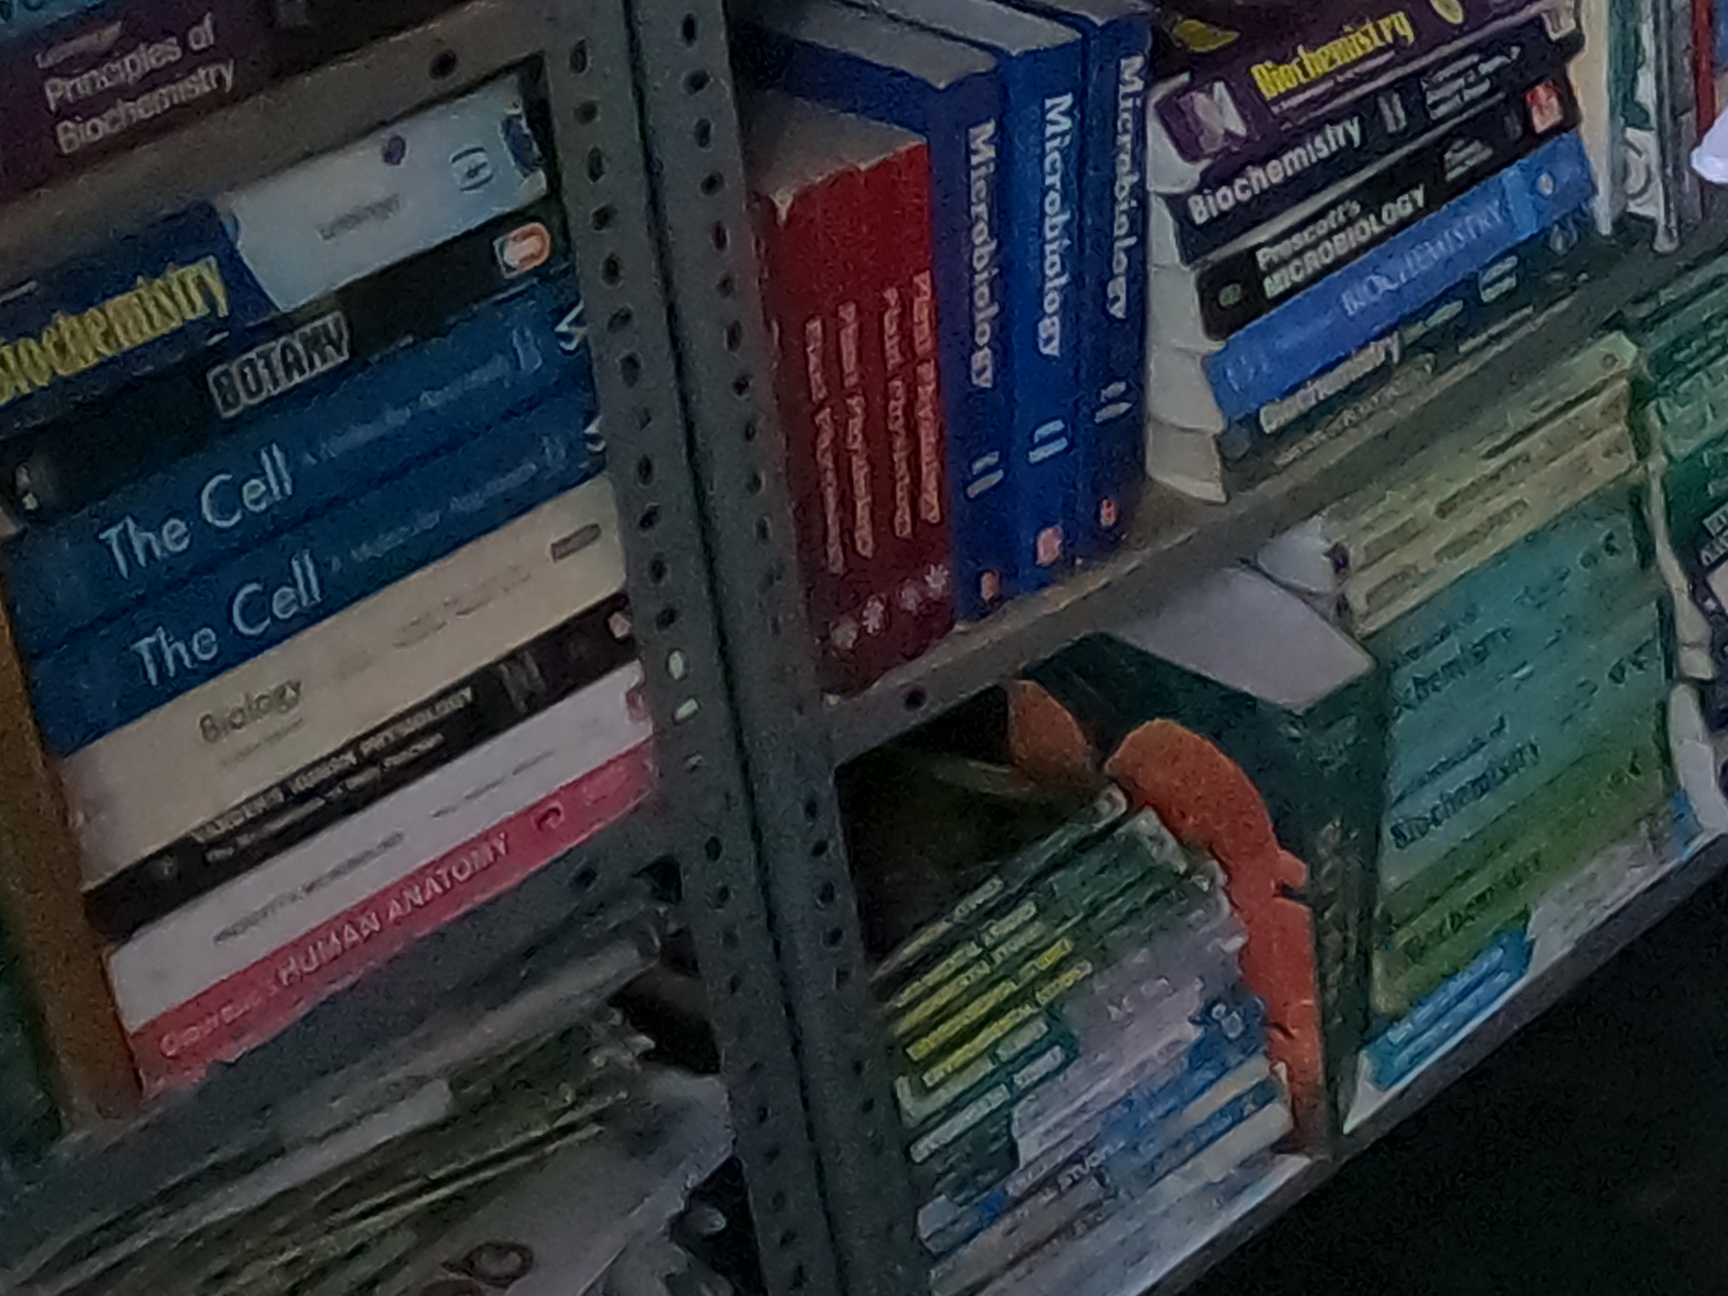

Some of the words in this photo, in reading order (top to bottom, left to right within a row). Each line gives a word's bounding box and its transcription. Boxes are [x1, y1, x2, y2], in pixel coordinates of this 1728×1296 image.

[44, 38, 182, 112] Principles
[186, 11, 217, 53] of
[54, 59, 236, 156] Biochemistry
[1250, 7, 1416, 103] Biochemistry
[1037, 89, 1075, 363] Microbiology
[1106, 53, 1145, 322] Microbiology
[1186, 114, 1364, 228] Biochemistry
[966, 116, 998, 393] Microbiology
[1255, 195, 1363, 273] Prescott's
[1262, 182, 1427, 302] MICROBIOLOGY
[211, 311, 350, 413] BOTANY
[100, 515, 191, 580] The
[199, 442, 294, 529] Cell
[130, 624, 219, 687] The
[231, 550, 325, 638] Cell
[199, 675, 304, 738] Biology
[276, 907, 382, 987] HUMAN
[384, 831, 513, 929] ANATOMY
